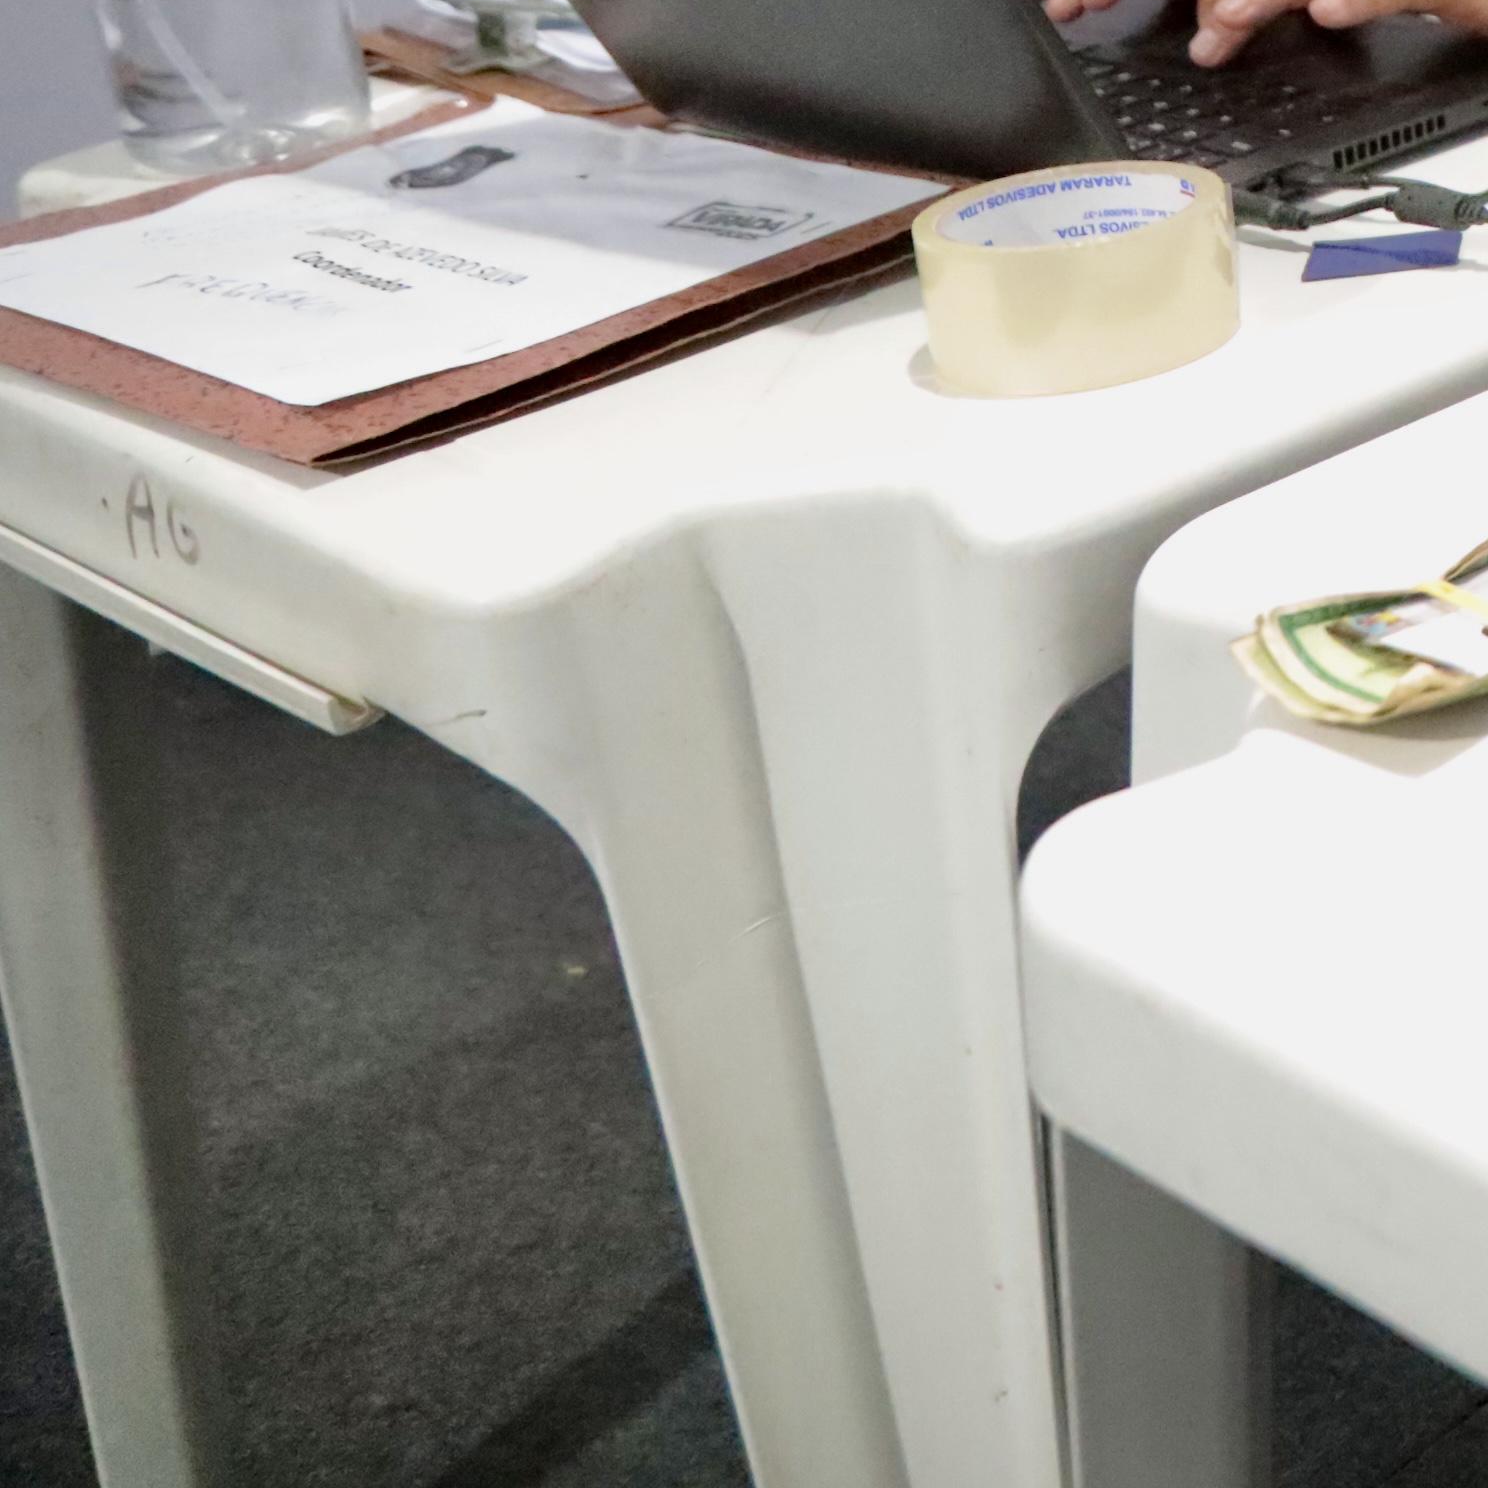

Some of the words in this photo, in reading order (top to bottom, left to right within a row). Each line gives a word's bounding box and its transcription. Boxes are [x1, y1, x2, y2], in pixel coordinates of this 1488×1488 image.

[985, 181, 1057, 209] ADESIVOS
[1059, 175, 1133, 193] TARARAM
[290, 250, 413, 293] Coordenador
